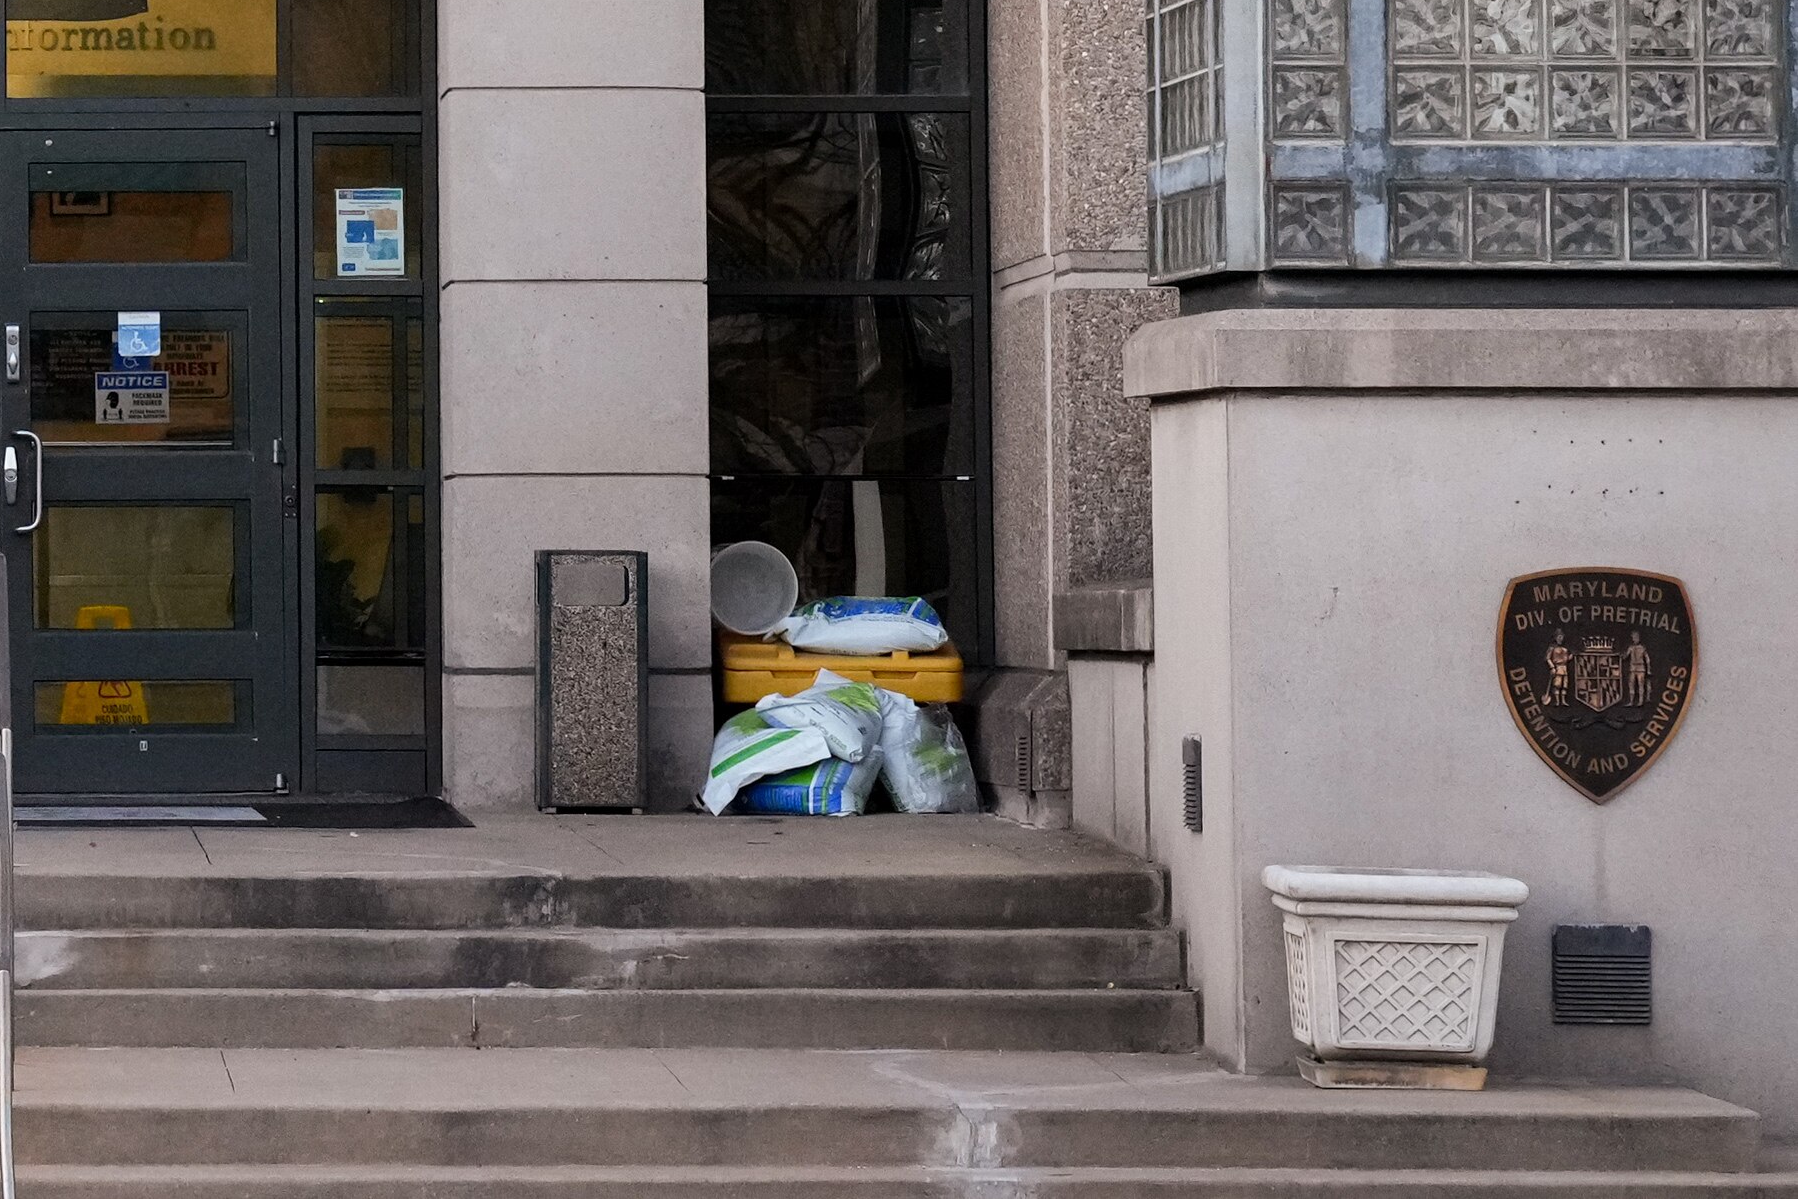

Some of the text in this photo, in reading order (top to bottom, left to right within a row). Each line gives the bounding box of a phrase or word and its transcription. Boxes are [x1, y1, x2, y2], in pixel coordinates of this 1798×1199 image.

[101, 375, 164, 387] NOTICE
[1533, 580, 1664, 604] MARYLAND
[1515, 604, 1681, 635] DIV. OF PRETRIAL
[101, 704, 133, 714] CUIDADO
[1509, 664, 1688, 775] DETENTION AND SERVICES
